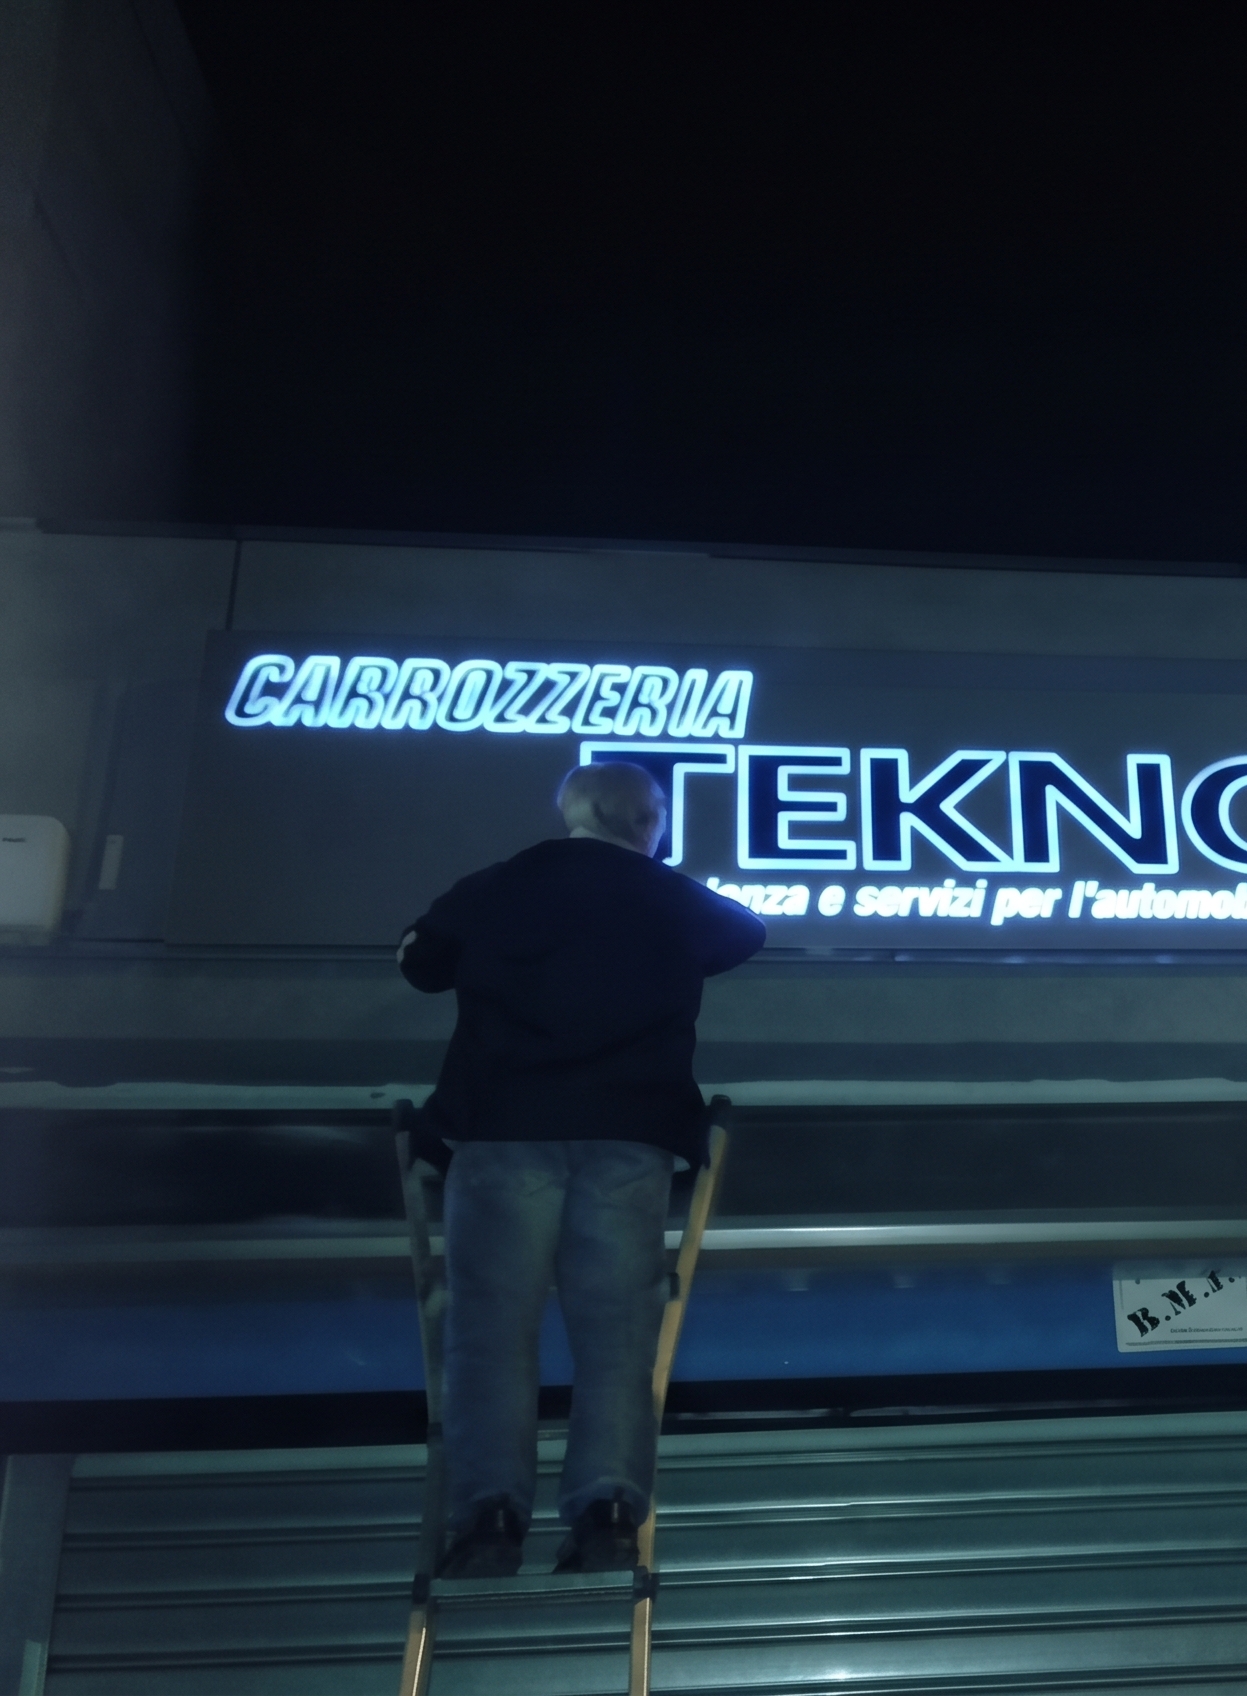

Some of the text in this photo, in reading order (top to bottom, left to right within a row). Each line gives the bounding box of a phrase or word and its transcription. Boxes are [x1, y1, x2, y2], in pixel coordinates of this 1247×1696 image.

[224, 653, 754, 738] CARROZZERIA
[818, 885, 846, 917] e
[853, 879, 988, 917] servizi
[990, 887, 1063, 926] per
